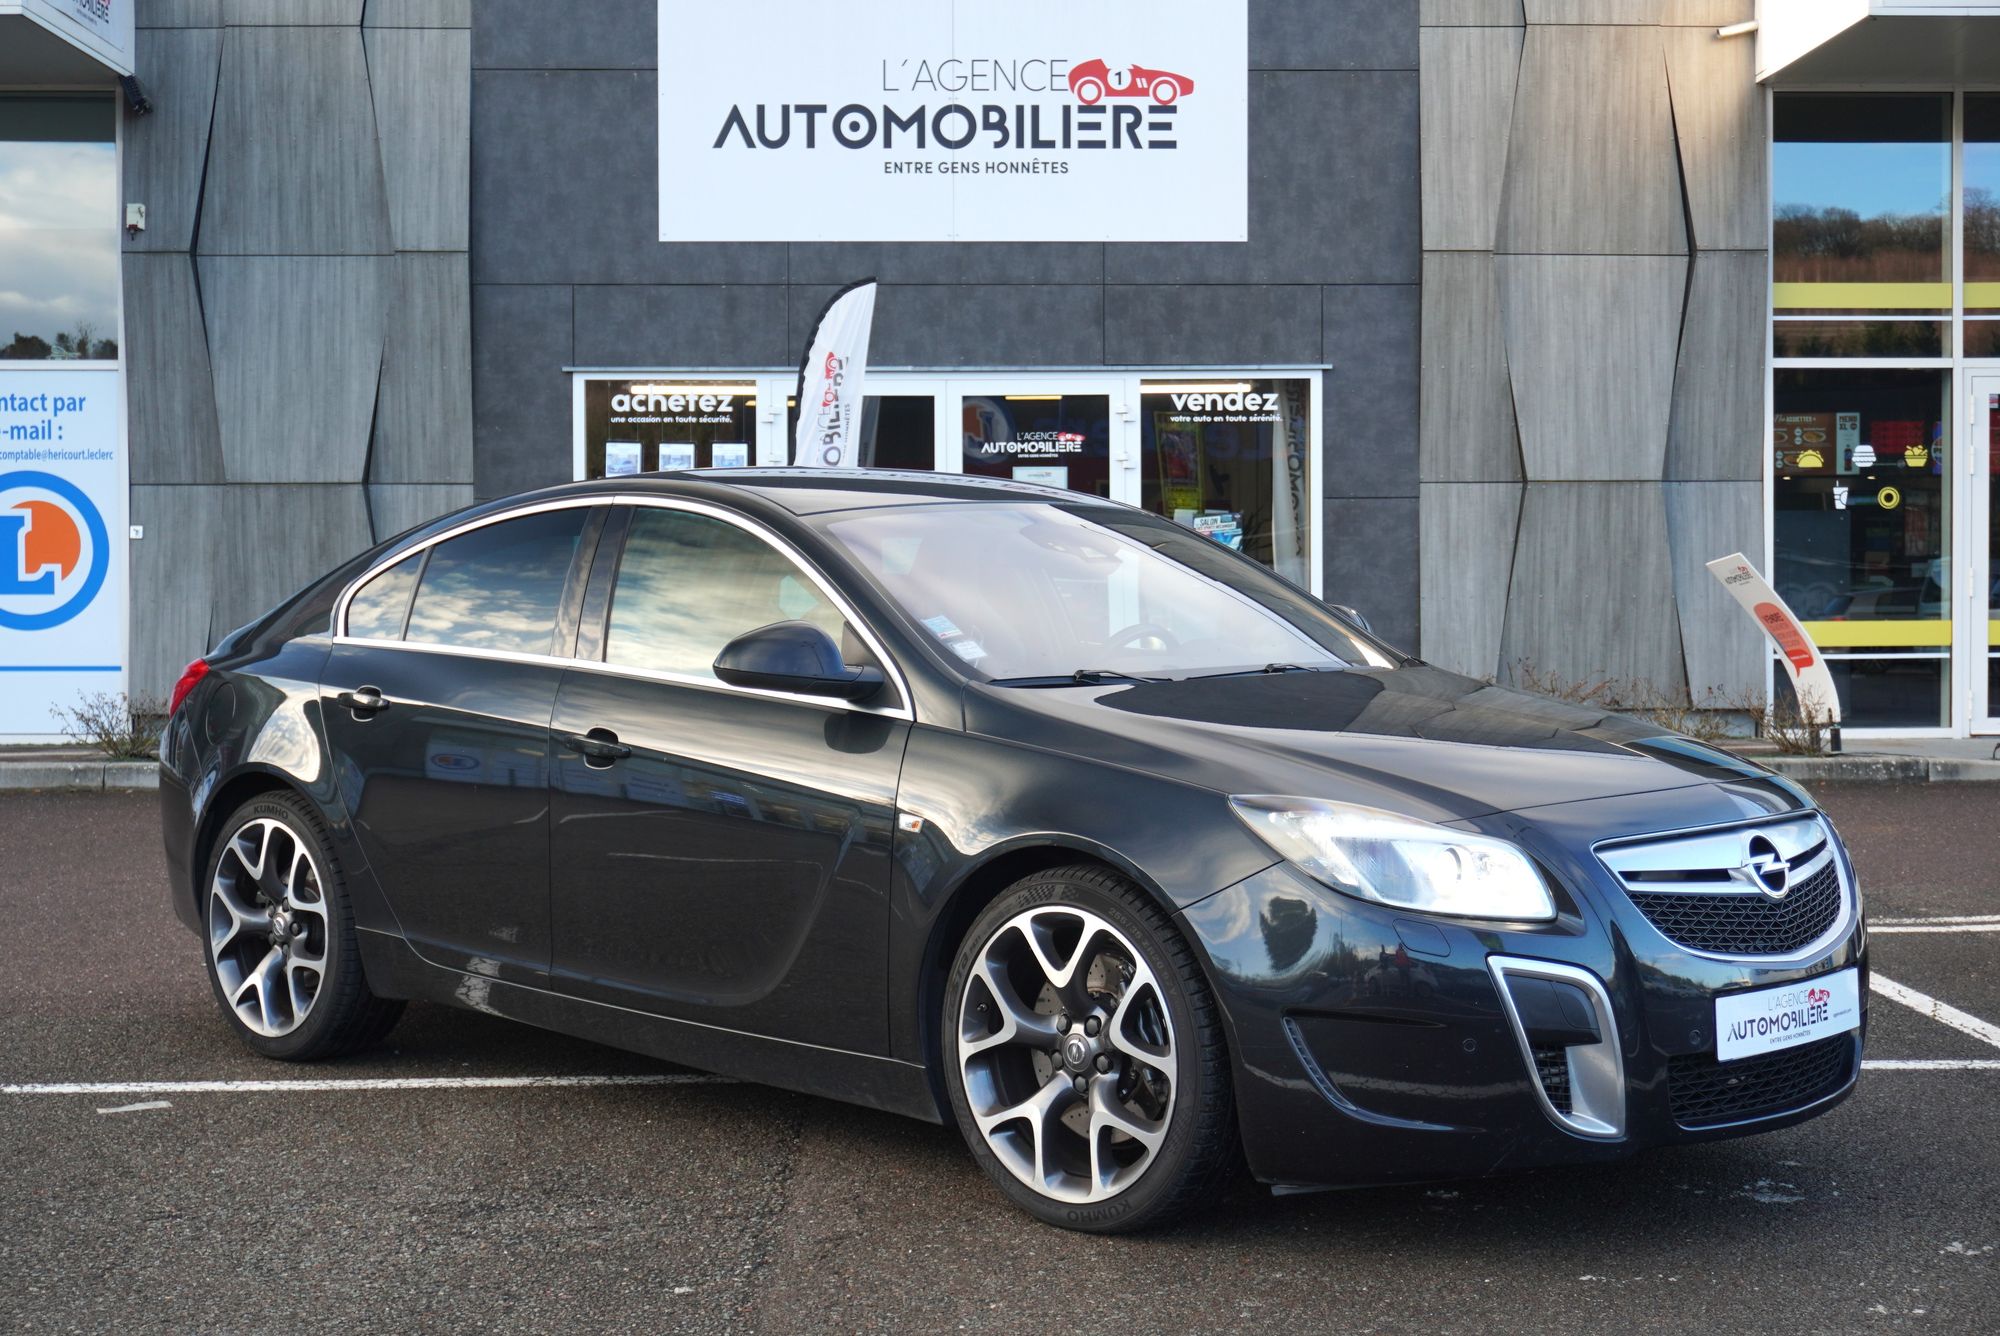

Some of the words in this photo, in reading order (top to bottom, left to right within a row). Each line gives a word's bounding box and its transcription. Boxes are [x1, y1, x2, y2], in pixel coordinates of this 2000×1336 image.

[883, 59, 1068, 91] L'AGENCE
[1114, 71, 1122, 86] 1
[884, 162, 933, 174] ENTRE
[938, 162, 980, 174] GENS
[985, 158, 1069, 174] HONNÊTES
[53, 396, 86, 417] par
[611, 384, 733, 412] achetez
[1170, 383, 1279, 412] vendez
[628, 415, 661, 423] occasion
[675, 415, 697, 423] toute
[699, 414, 733, 423] sécurité.
[1170, 415, 1191, 423] votre
[1193, 415, 1212, 423] auto
[1225, 415, 1248, 423] toute
[0, 419, 51, 440] -mail
[1016, 431, 1058, 441] L'AGENCE
[1199, 517, 1219, 527] SALON
[254, 805, 288, 819] KUMHO
[1767, 989, 1809, 1011] L'AGENCE
[1067, 1199, 1132, 1222] KUMHO
